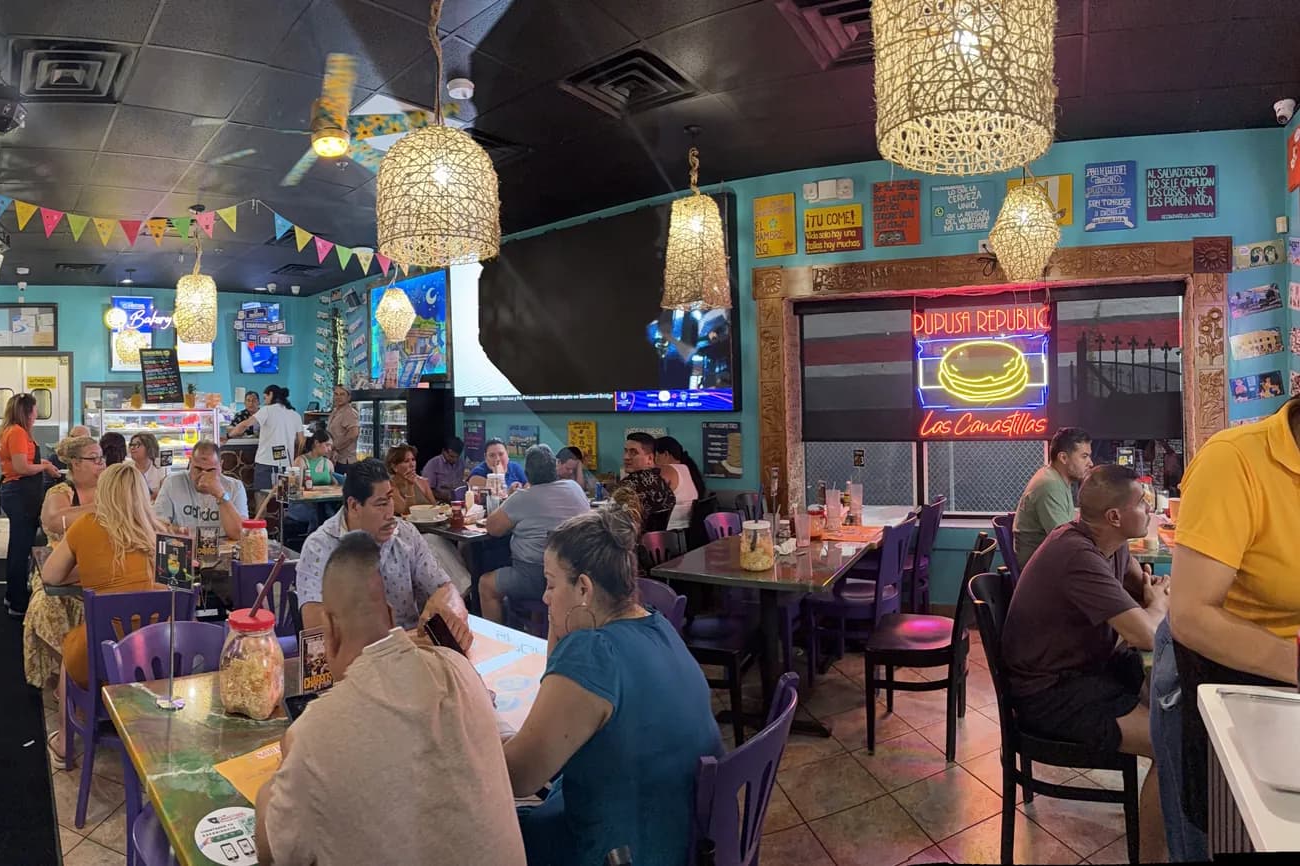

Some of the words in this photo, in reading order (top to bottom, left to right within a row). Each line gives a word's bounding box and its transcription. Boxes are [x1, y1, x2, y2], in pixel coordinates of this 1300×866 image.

[1147, 169, 1157, 178] AL
[1157, 167, 1208, 178] SALVADOREÑO
[1148, 180, 1159, 189] NO
[1161, 179, 1170, 189] SE
[948, 191, 982, 204] CERVEZA
[1148, 188, 1162, 197] LAS
[1196, 187, 1206, 196] SE
[1148, 198, 1162, 207] LES
[1164, 197, 1192, 207] PONEN
[1194, 195, 1214, 206] YUCA
[826, 209, 855, 225] COME!
[836, 239, 860, 249] muchas
[126, 309, 173, 330] Bakery
[913, 310, 971, 335] PUPUSA
[977, 306, 1051, 332] REPUBLIC
[920, 411, 952, 436] Las
[954, 410, 1048, 437] Canastillas
[183, 504, 220, 522] adida
